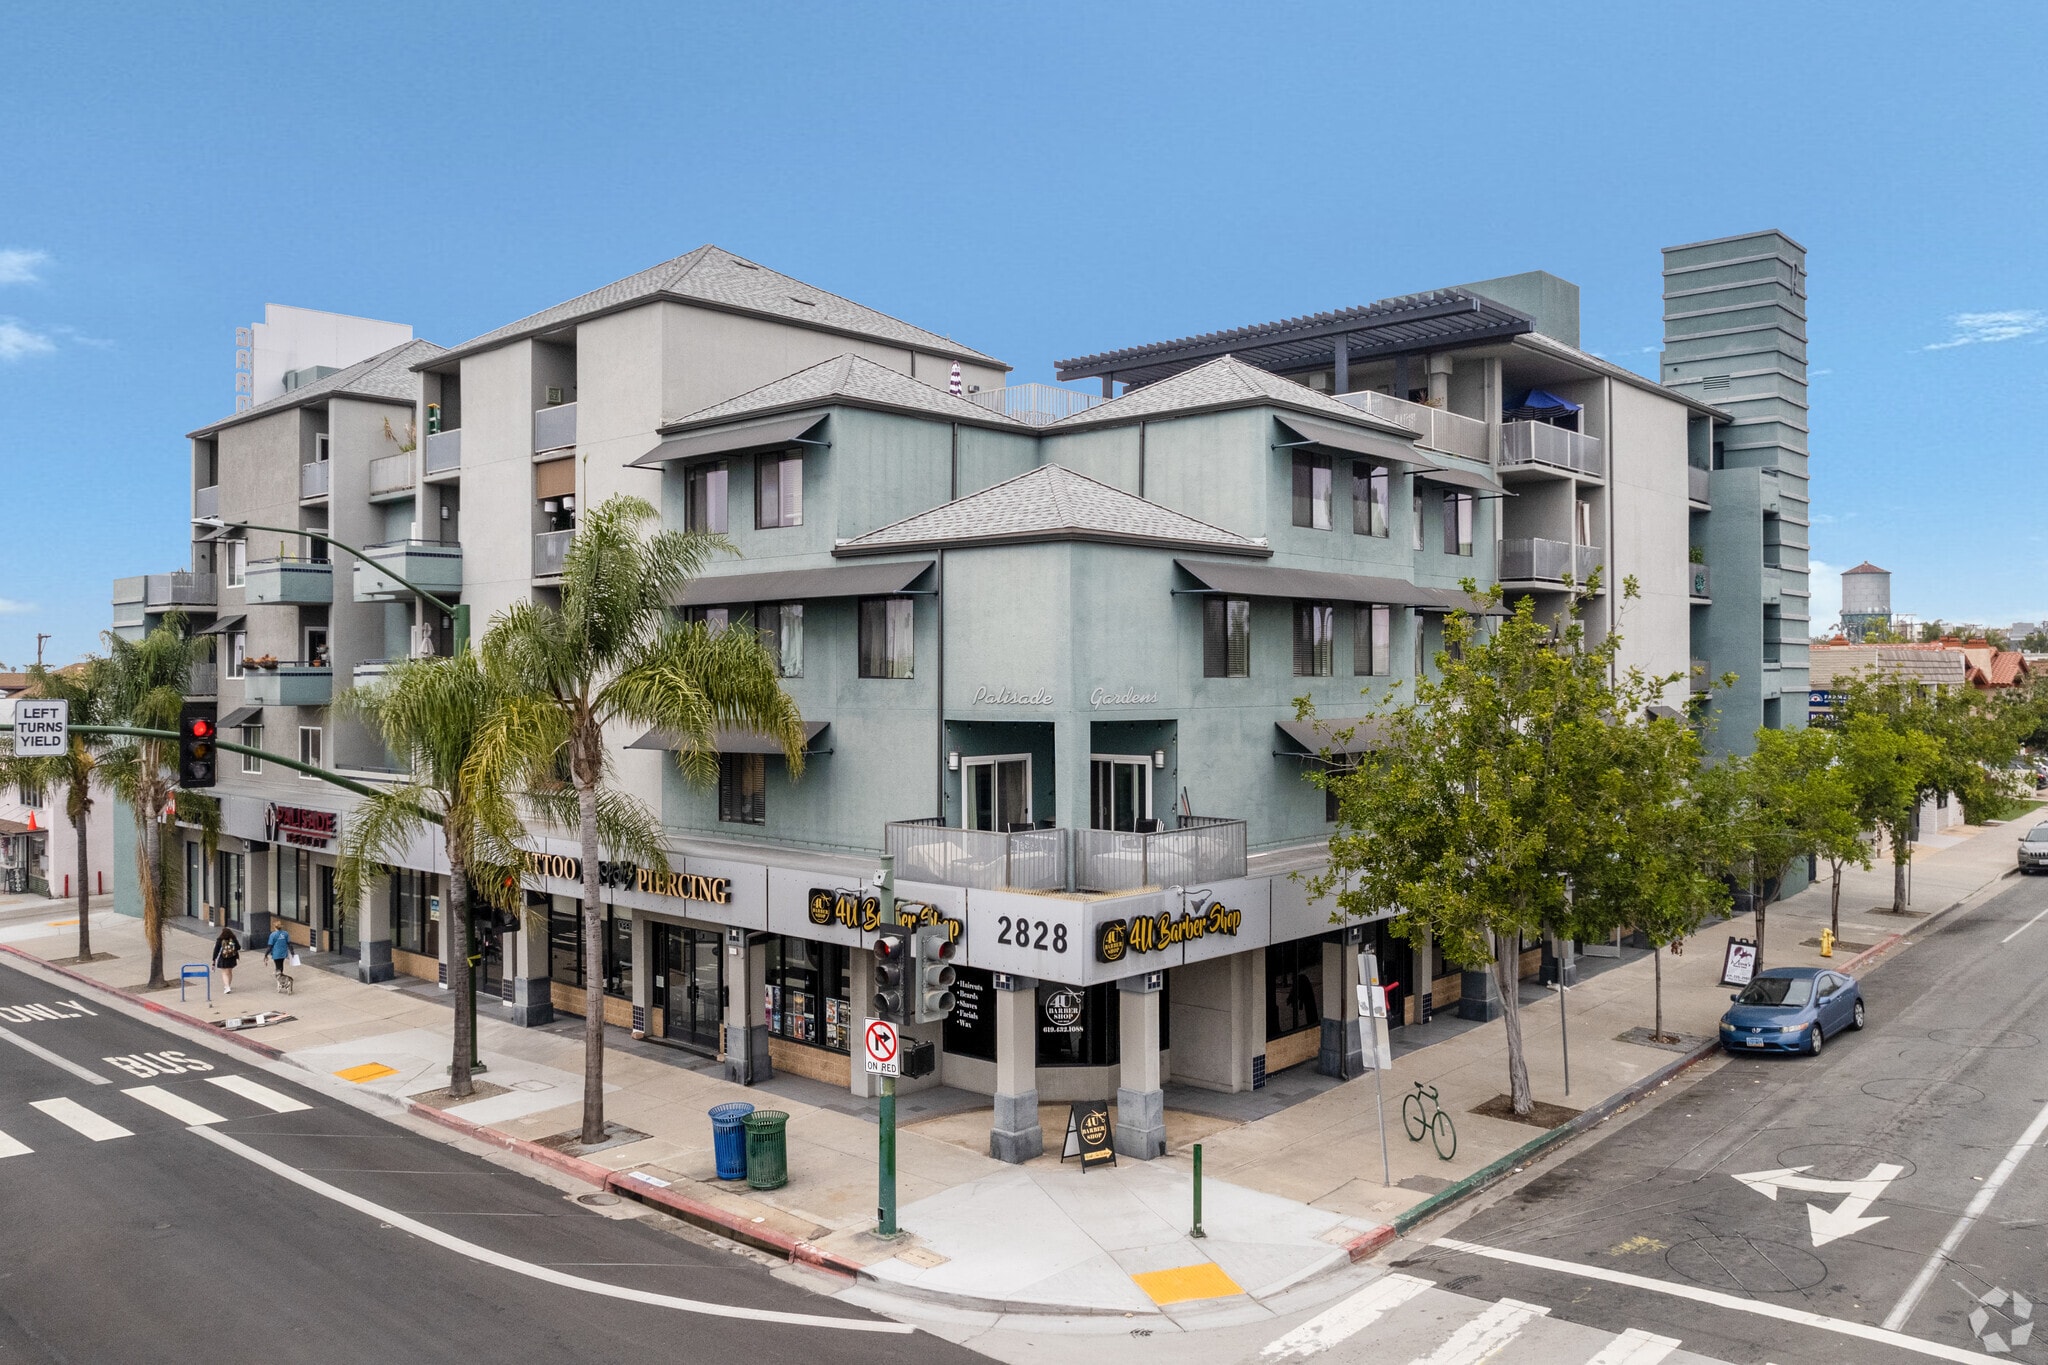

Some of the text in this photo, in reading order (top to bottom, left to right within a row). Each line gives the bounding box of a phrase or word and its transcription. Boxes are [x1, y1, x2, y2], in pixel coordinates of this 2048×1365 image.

[972, 686, 1160, 710] Palisade Gardens
[23, 708, 60, 719] LEFT
[17, 721, 64, 734] TURNS
[20, 735, 62, 747] YIELD
[277, 806, 336, 832] PALISADE
[523, 852, 577, 881] ATTOO
[637, 867, 728, 905] PIERCING
[835, 896, 858, 928] 4U
[997, 915, 1067, 954] 2828
[1129, 902, 1242, 954] 4U Barber Shop
[0, 1000, 98, 1023] ONLY
[1049, 994, 1072, 1008] 4U
[102, 1050, 214, 1079] BUS
[867, 1061, 897, 1073] ON RED
